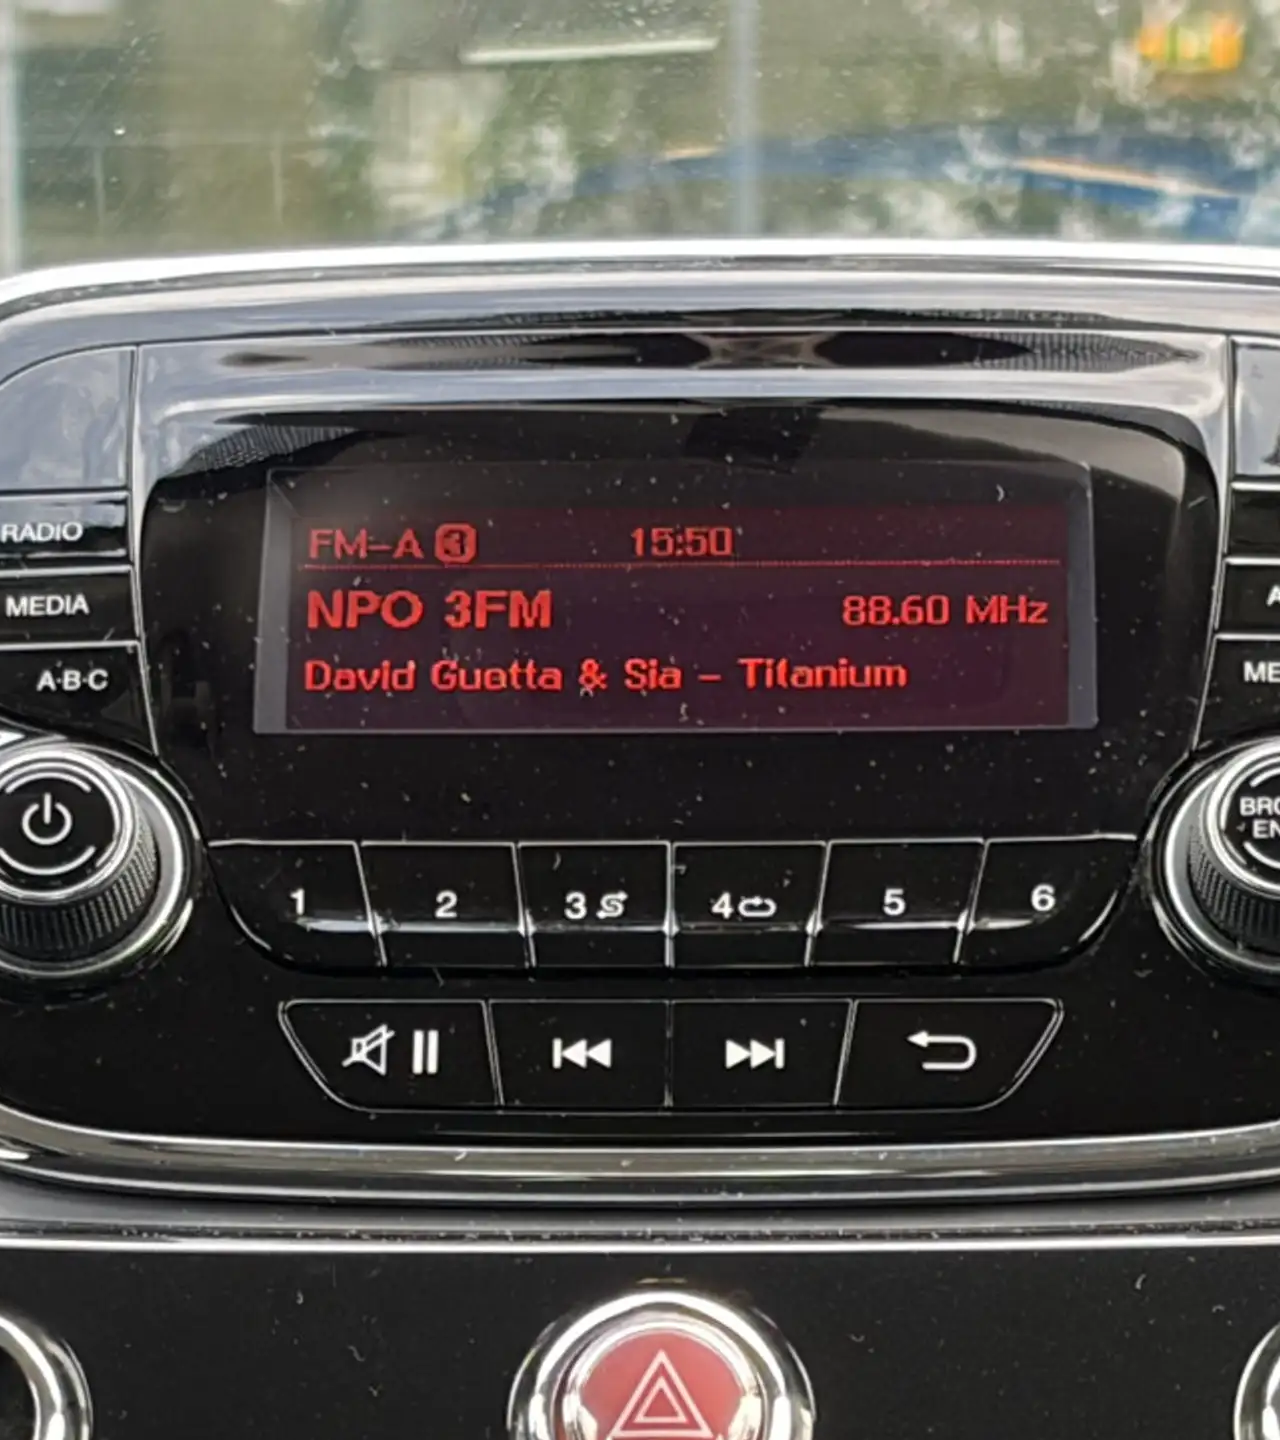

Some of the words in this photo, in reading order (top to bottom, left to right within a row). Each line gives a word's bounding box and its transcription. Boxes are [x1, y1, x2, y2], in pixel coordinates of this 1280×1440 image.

[1, 522, 84, 543] RADIO
[309, 528, 425, 559] FM-A
[631, 526, 734, 557] 15:50
[5, 594, 91, 617] MEDIA
[306, 589, 425, 629] NPO
[443, 589, 552, 629] 3FM
[841, 594, 950, 626] 88.60
[965, 593, 1050, 625] MHz
[304, 658, 416, 692] David
[431, 657, 563, 691] Guetta
[577, 657, 608, 692] &
[624, 656, 682, 690] Sia
[738, 656, 908, 690] Titanium
[288, 888, 307, 915] 1
[435, 890, 458, 919] 2
[564, 891, 587, 920] 3
[710, 891, 733, 920] 4
[883, 887, 906, 915] 5
[1031, 883, 1055, 912] 6
